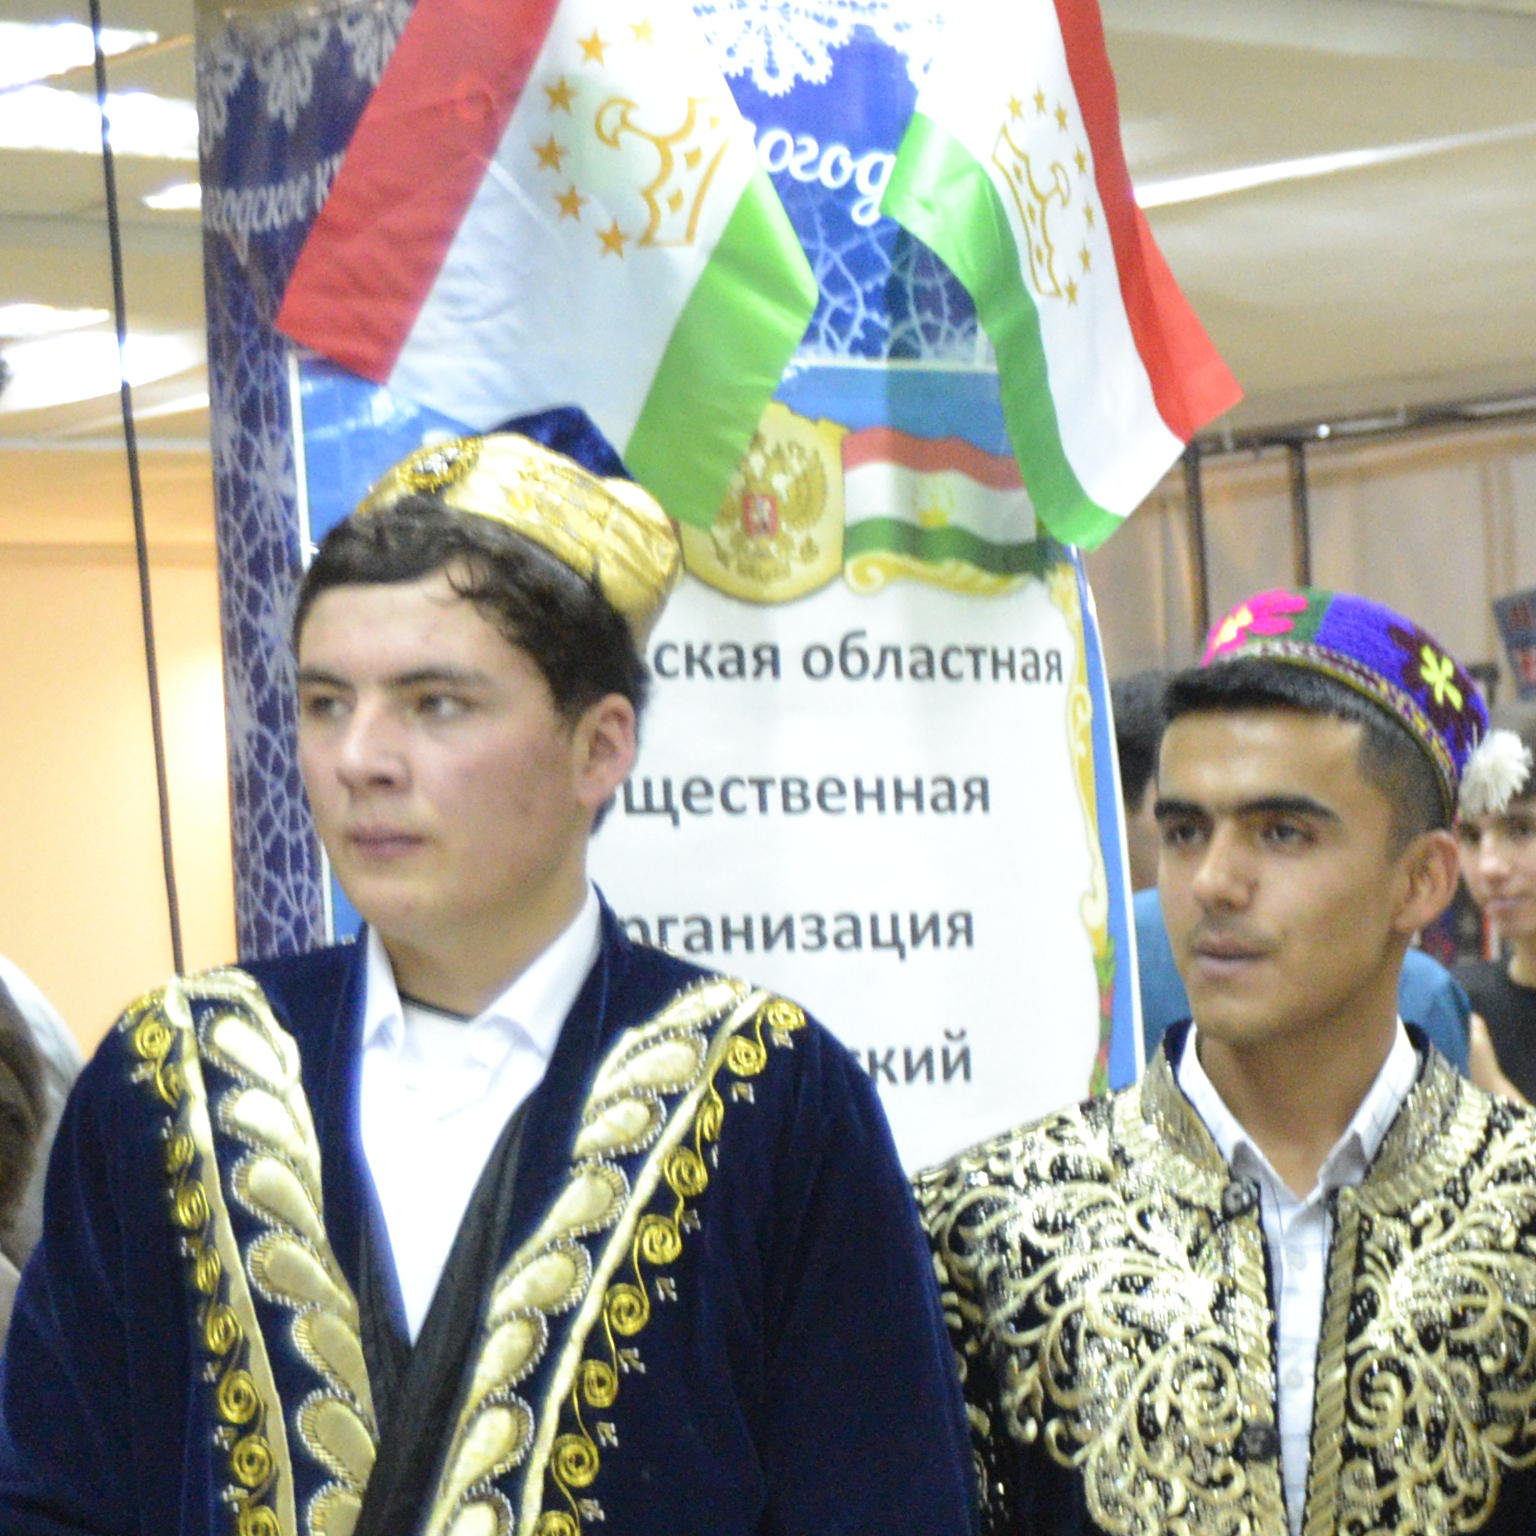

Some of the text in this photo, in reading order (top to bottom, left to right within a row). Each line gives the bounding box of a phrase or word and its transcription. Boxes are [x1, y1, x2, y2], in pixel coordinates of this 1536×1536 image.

[745, 120, 896, 226] огод
[653, 628, 1063, 684] ская областная
[622, 772, 991, 828] щественная
[617, 910, 974, 962] рганизация
[849, 1028, 972, 1084] кий
